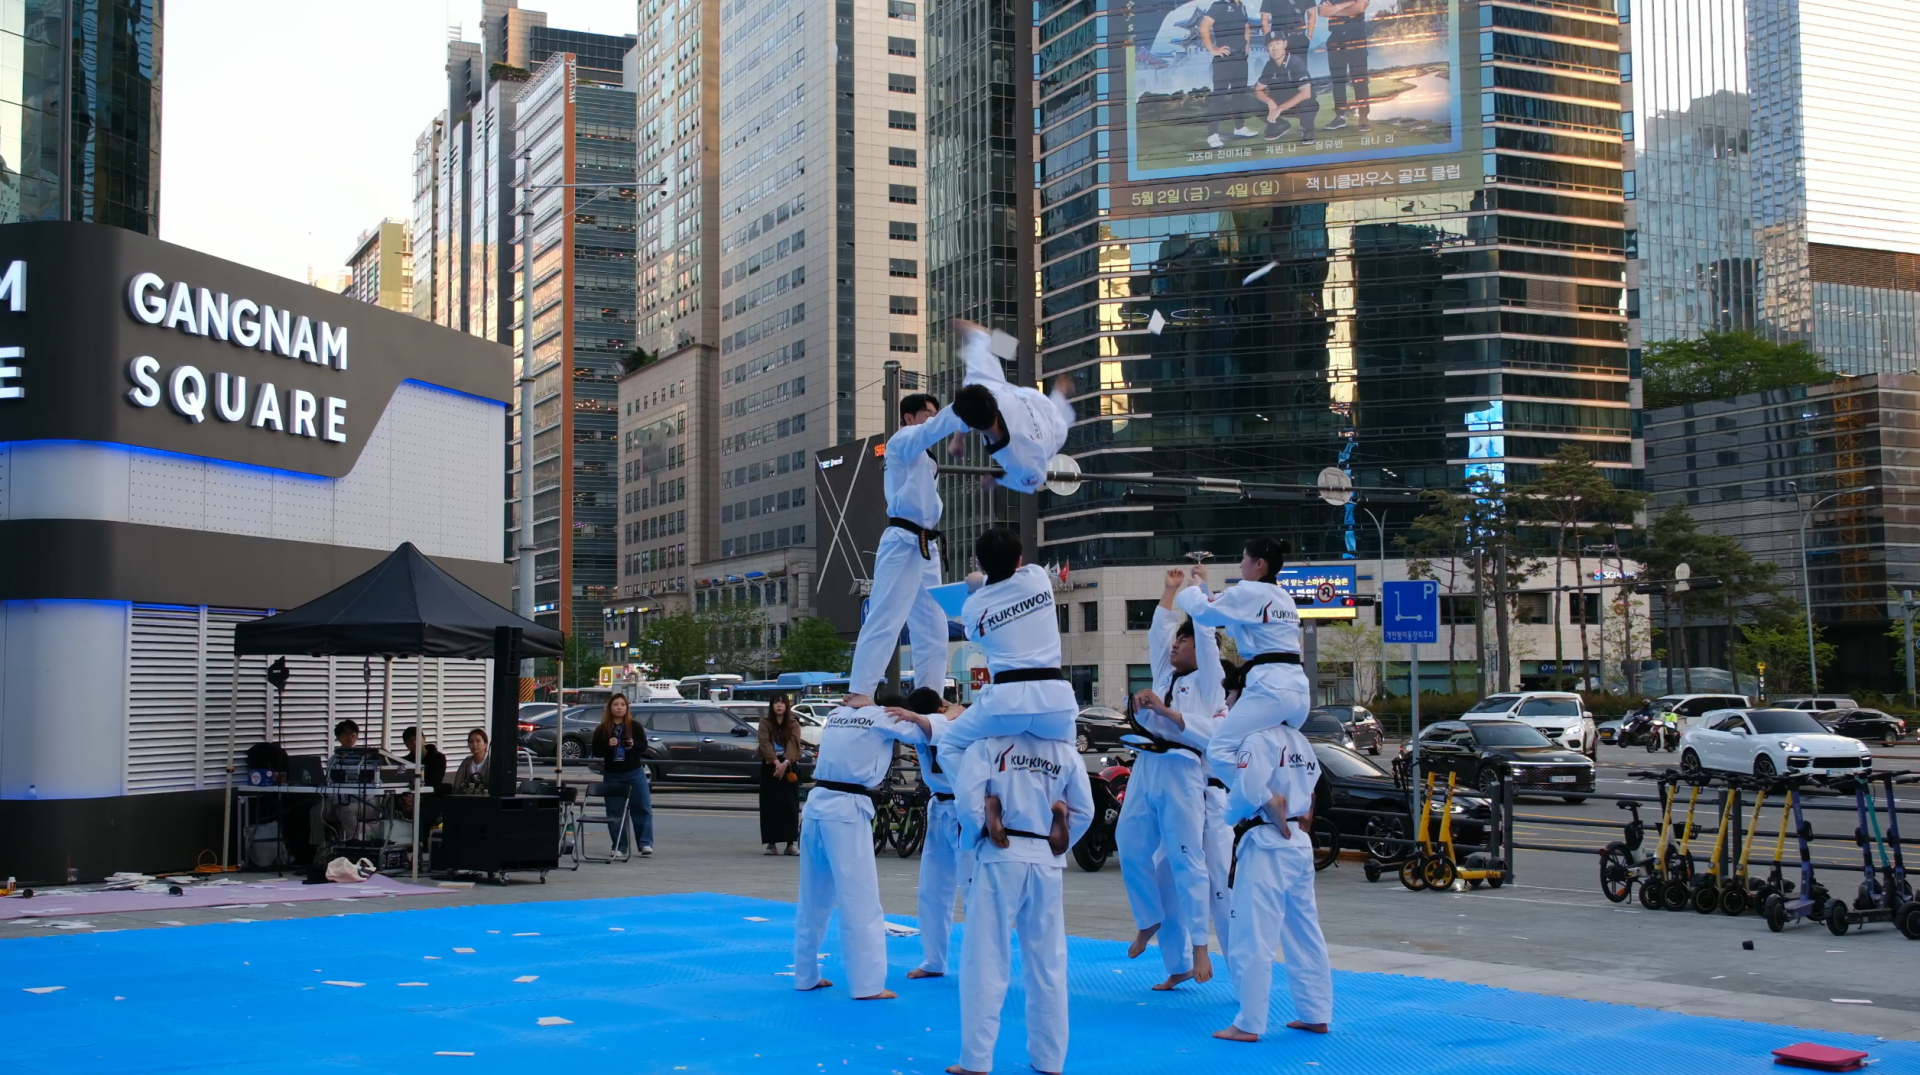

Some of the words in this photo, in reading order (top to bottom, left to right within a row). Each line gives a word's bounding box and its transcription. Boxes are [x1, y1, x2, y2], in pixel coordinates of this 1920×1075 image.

[1132, 191, 1153, 206] 5월
[1157, 189, 1180, 204] 2일
[1225, 183, 1248, 198] 4일
[1306, 176, 1320, 191] 잭
[1324, 171, 1394, 190] 니클라우스
[1398, 167, 1427, 184] 골프
[1431, 164, 1461, 181] 클럽
[128, 272, 347, 370] GANGNAM
[128, 355, 347, 443] SQUARE
[987, 590, 1052, 627] KUKKIWON
[1423, 583, 1435, 600] P
